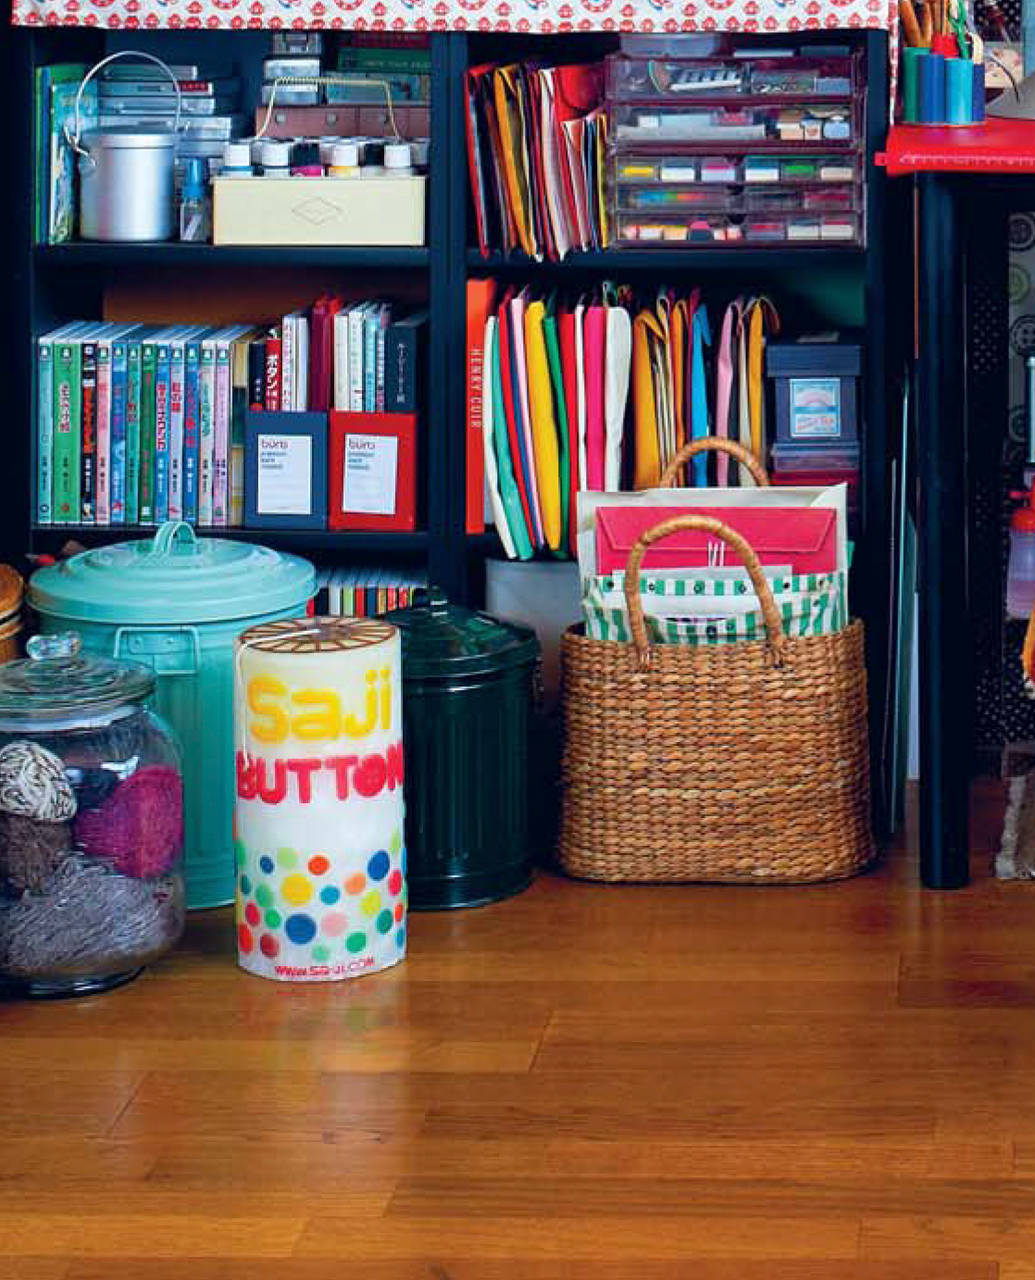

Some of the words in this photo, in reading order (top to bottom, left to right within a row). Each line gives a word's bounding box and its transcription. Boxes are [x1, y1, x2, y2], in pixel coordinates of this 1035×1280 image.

[470, 348, 483, 392] HENRY
[470, 396, 483, 429] CUIR
[236, 740, 403, 805] BUTTON
